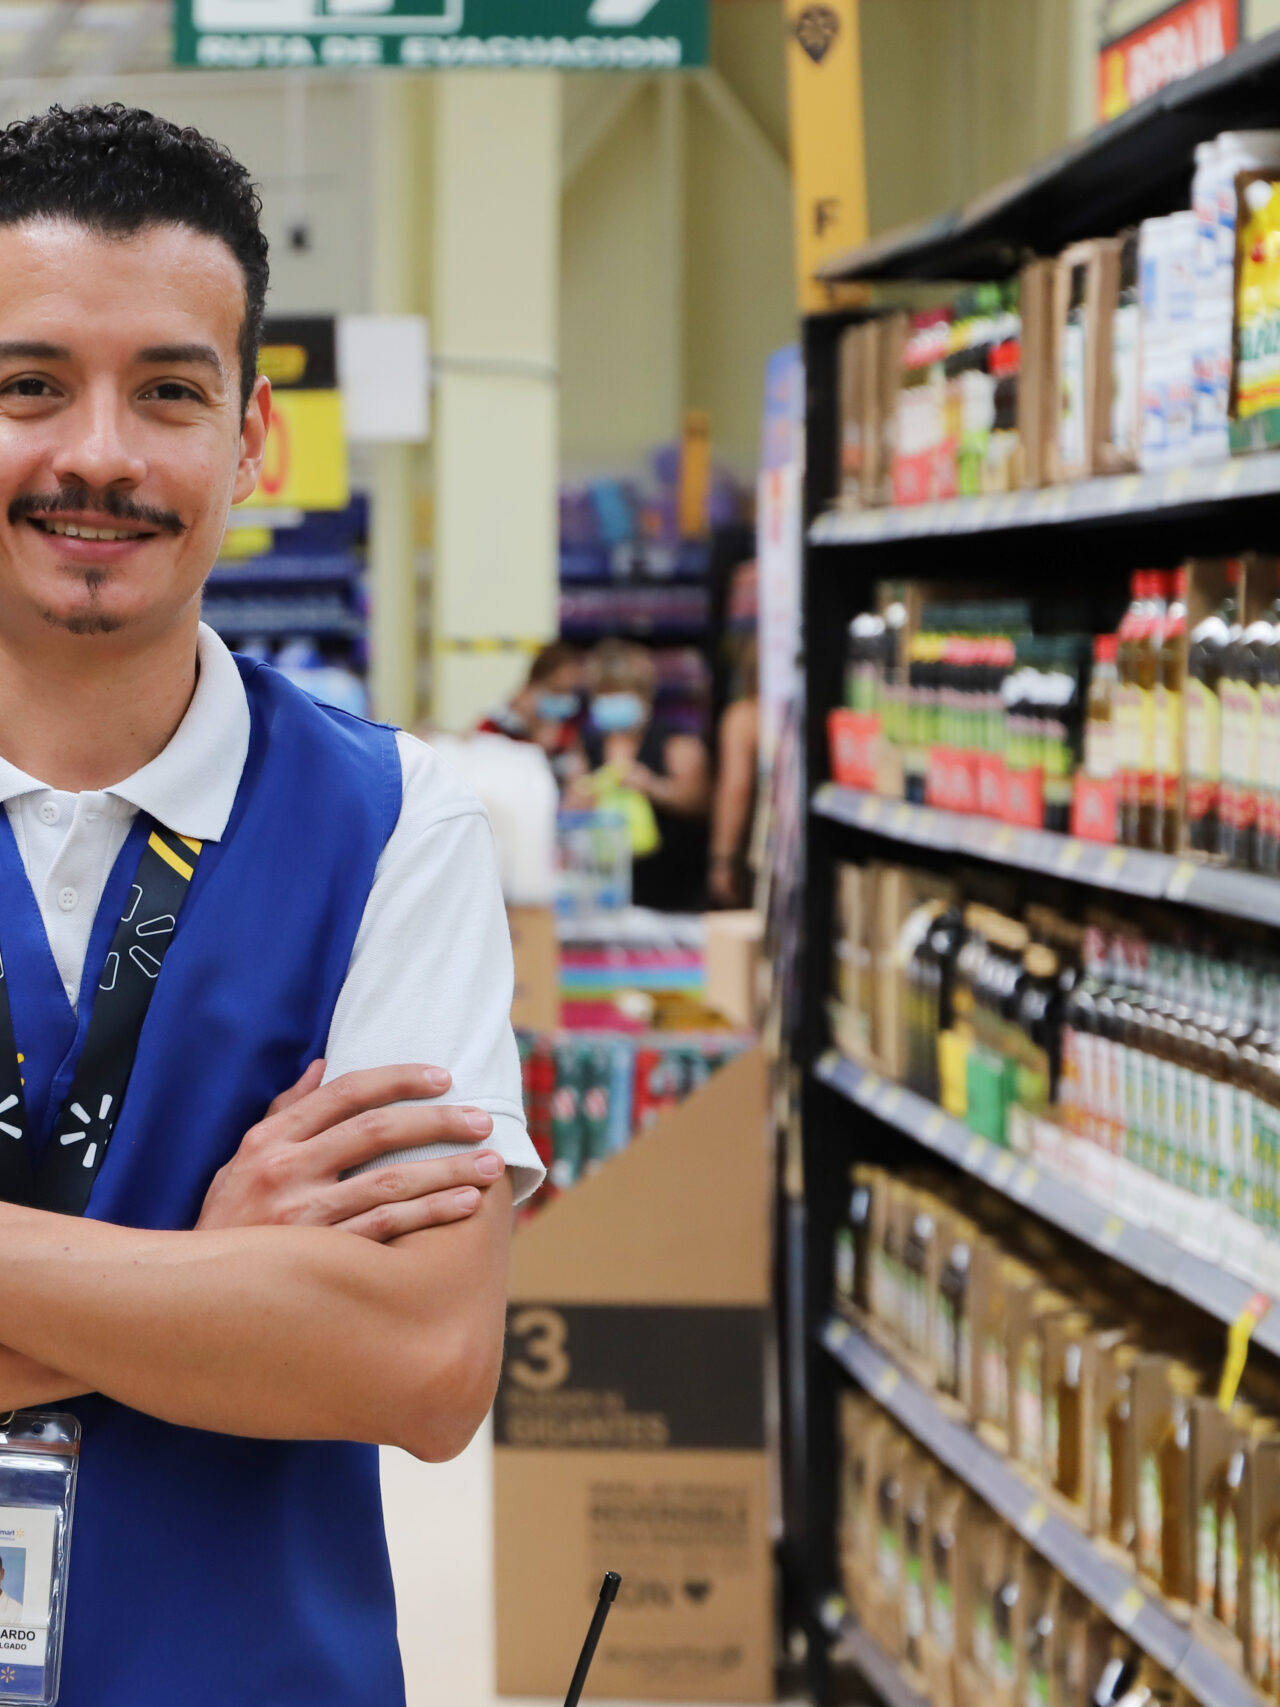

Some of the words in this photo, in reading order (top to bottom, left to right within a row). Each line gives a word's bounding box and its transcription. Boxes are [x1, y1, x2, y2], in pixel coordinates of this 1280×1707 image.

[197, 35, 315, 67] RUTA
[322, 35, 384, 67] DE
[509, 1309, 570, 1390] 3
